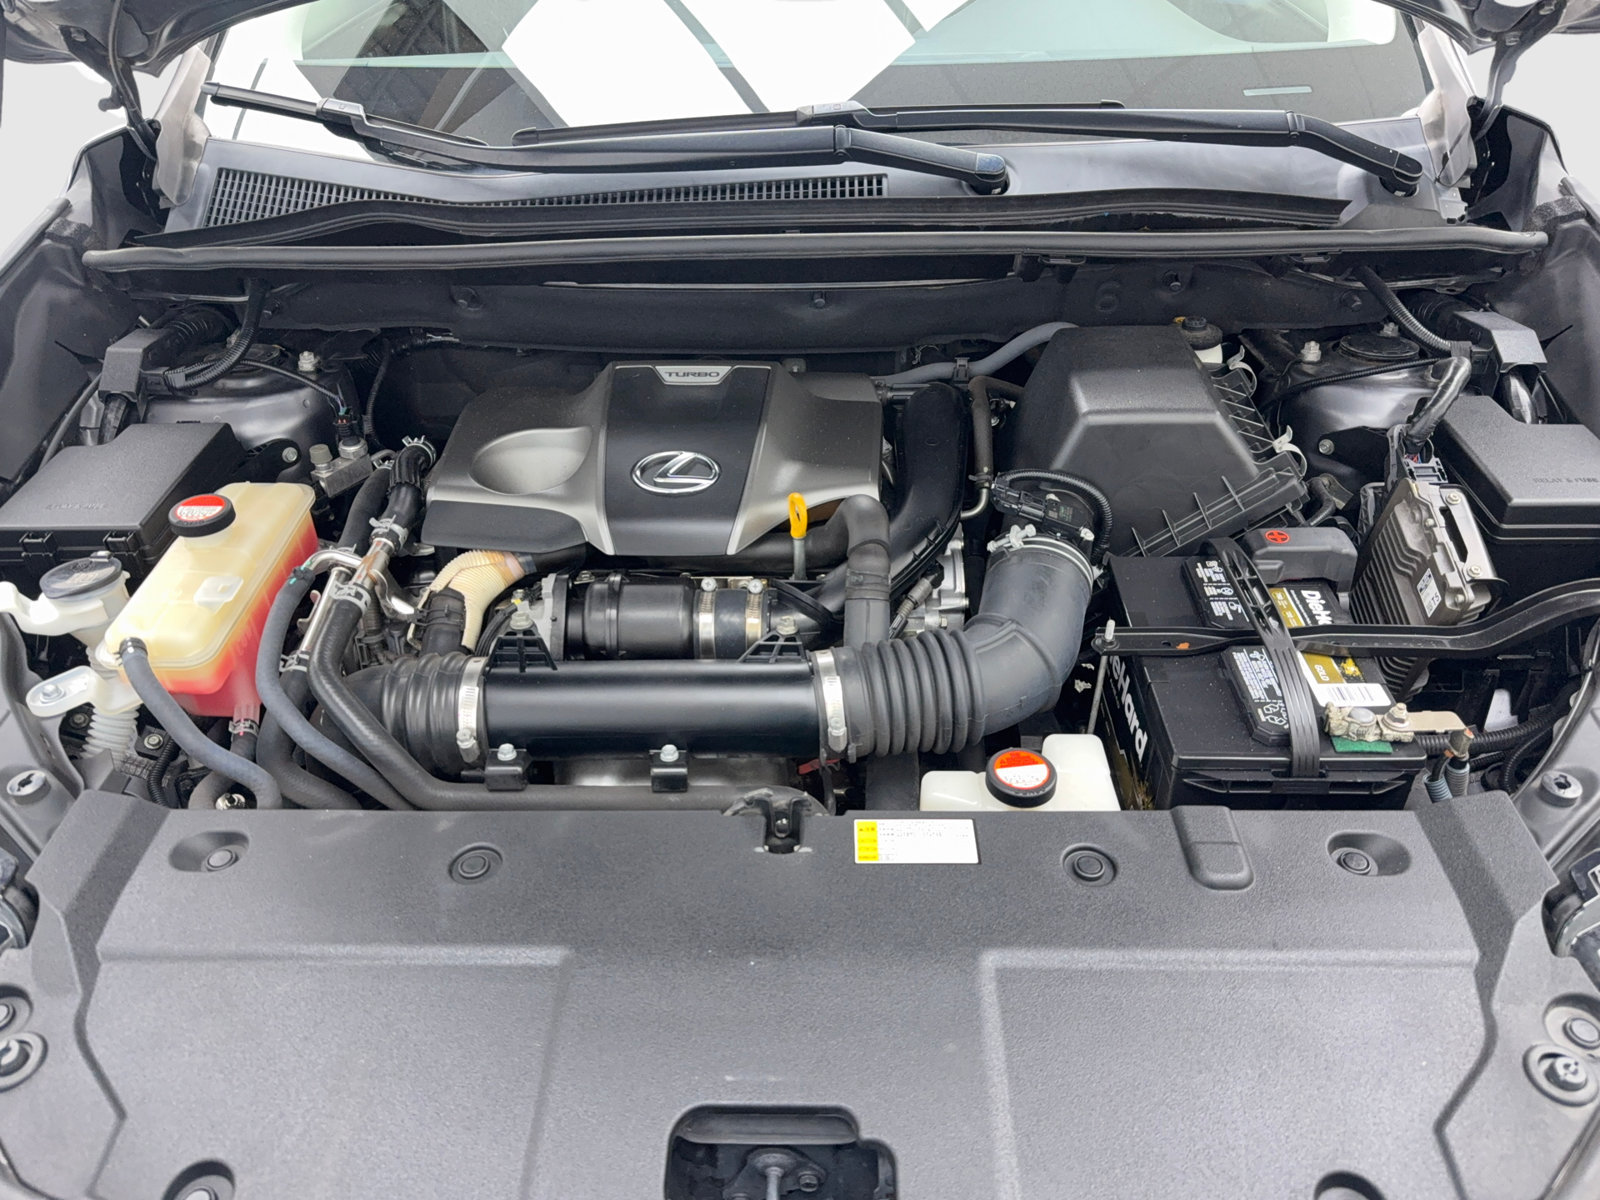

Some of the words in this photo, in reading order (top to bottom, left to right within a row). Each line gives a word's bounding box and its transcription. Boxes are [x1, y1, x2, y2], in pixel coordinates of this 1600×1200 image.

[1301, 590, 1333, 625] DieH
[1314, 664, 1330, 681] GOLD
[1109, 655, 1148, 763] eHard
